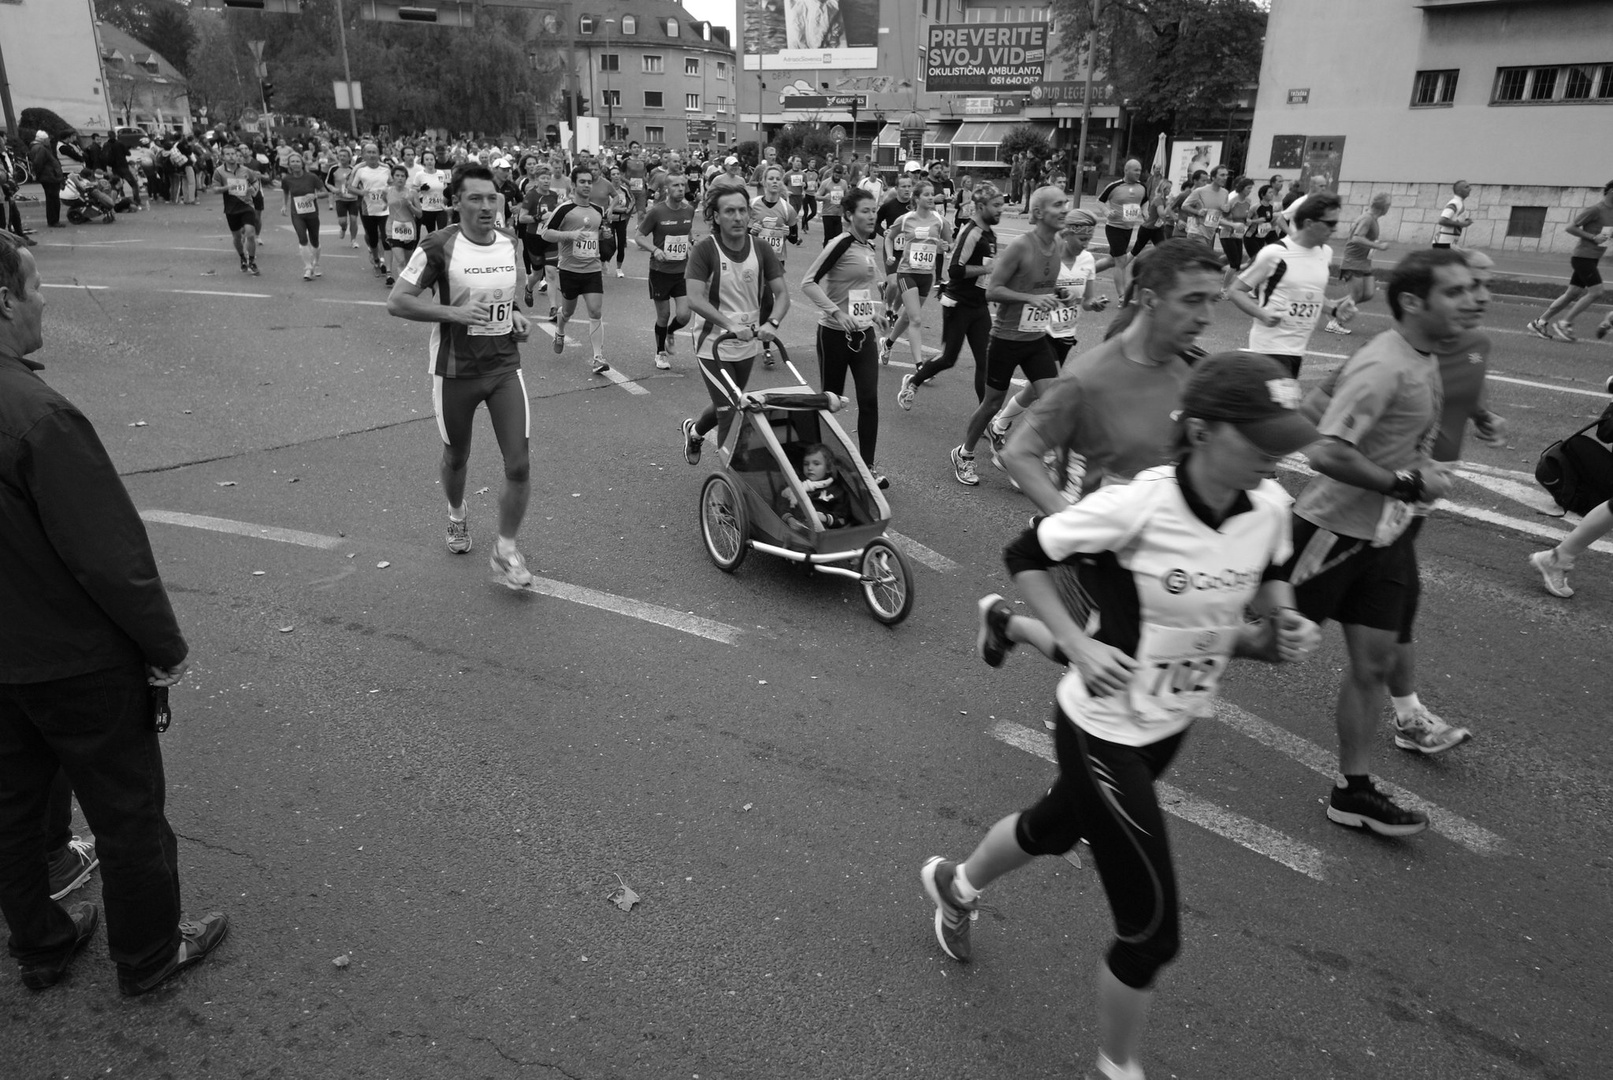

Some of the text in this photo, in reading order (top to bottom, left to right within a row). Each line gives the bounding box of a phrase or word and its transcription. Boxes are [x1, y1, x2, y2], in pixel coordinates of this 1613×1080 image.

[930, 27, 1044, 47] PREVERITE
[929, 48, 983, 66] SVOJ
[988, 47, 1025, 65] VID
[929, 65, 1042, 76] OKULISTIČNA AMBULANTA
[990, 76, 1005, 85] 051
[1006, 76, 1022, 85] 640
[1042, 86, 1103, 100] PUB LEGEDE
[394, 227, 412, 235] 6580
[575, 240, 597, 250] 4700
[666, 243, 687, 253] 4409
[912, 252, 933, 263] 4340
[1289, 302, 1320, 318] 3237
